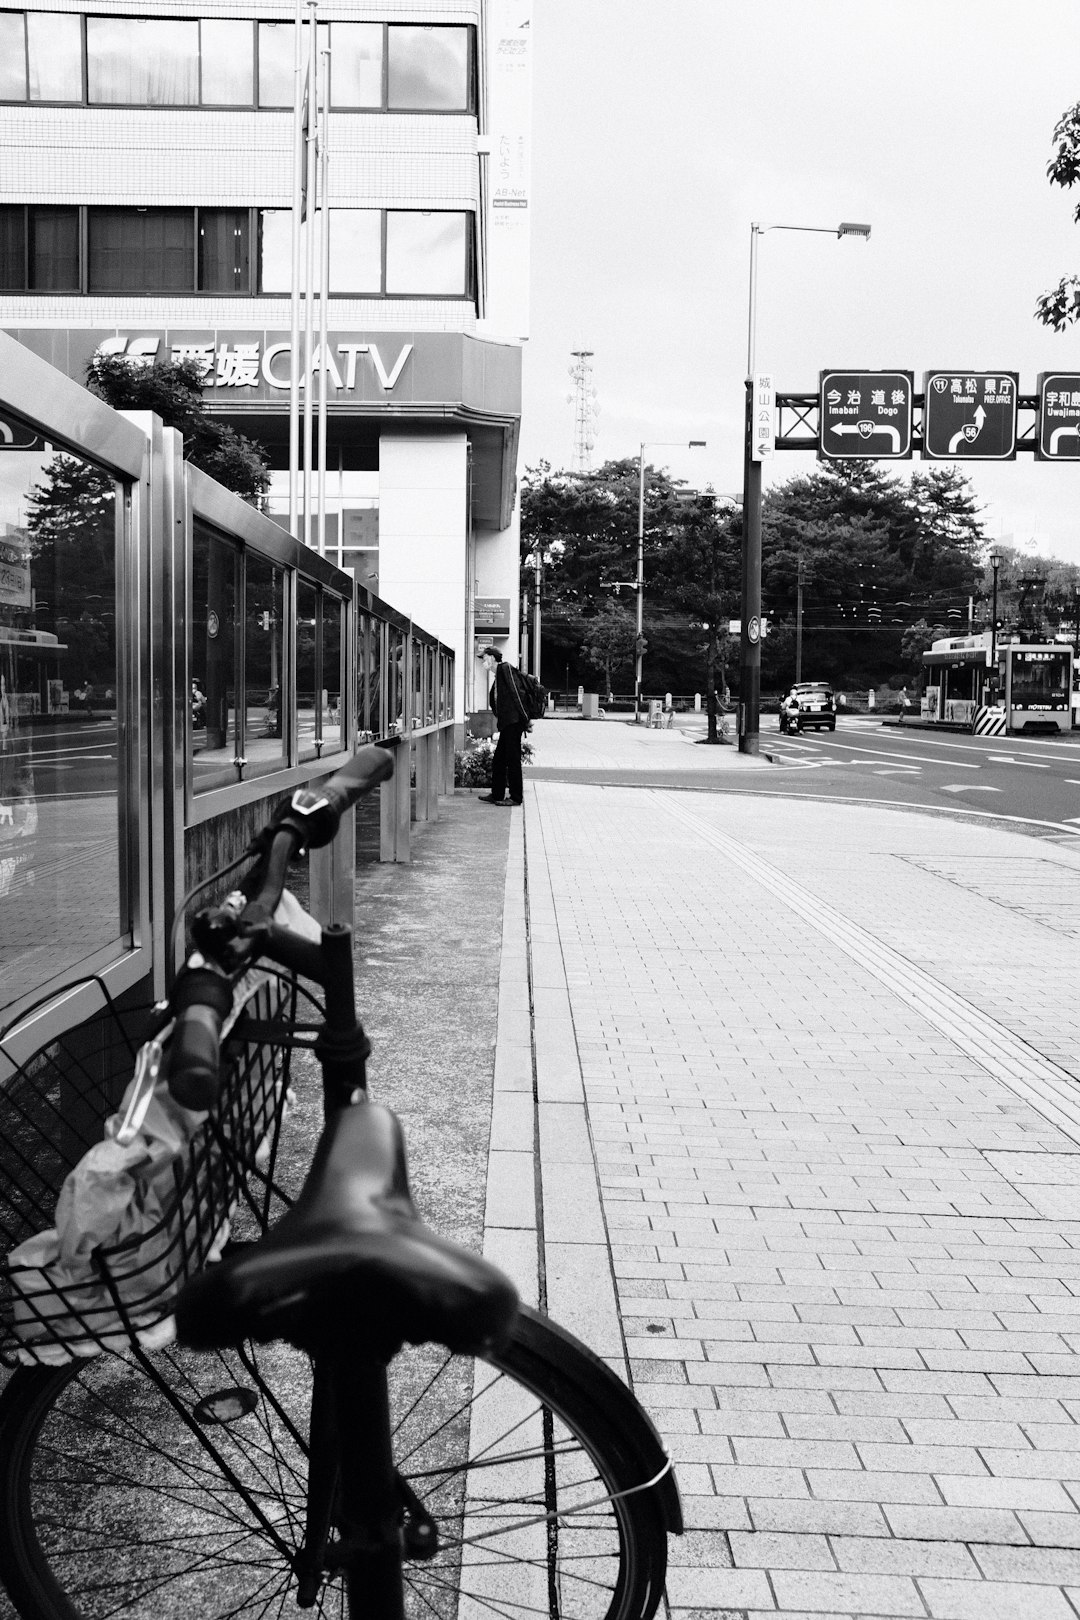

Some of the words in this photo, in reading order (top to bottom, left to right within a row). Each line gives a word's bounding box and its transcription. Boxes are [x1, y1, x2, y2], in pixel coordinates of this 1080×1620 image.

[495, 188, 526, 198] AB-Net
[935, 380, 945, 390] 11
[950, 378, 978, 394] 高松
[984, 378, 1012, 395] 県庁
[826, 388, 862, 405] 今治
[870, 388, 906, 405] 道後
[759, 377, 770, 439] 城山公園
[828, 405, 859, 415] Imabari
[877, 405, 899, 417] Dogo
[1047, 407, 1080, 418] Uwajima
[859, 423, 873, 433] 196
[965, 427, 977, 438] 56
